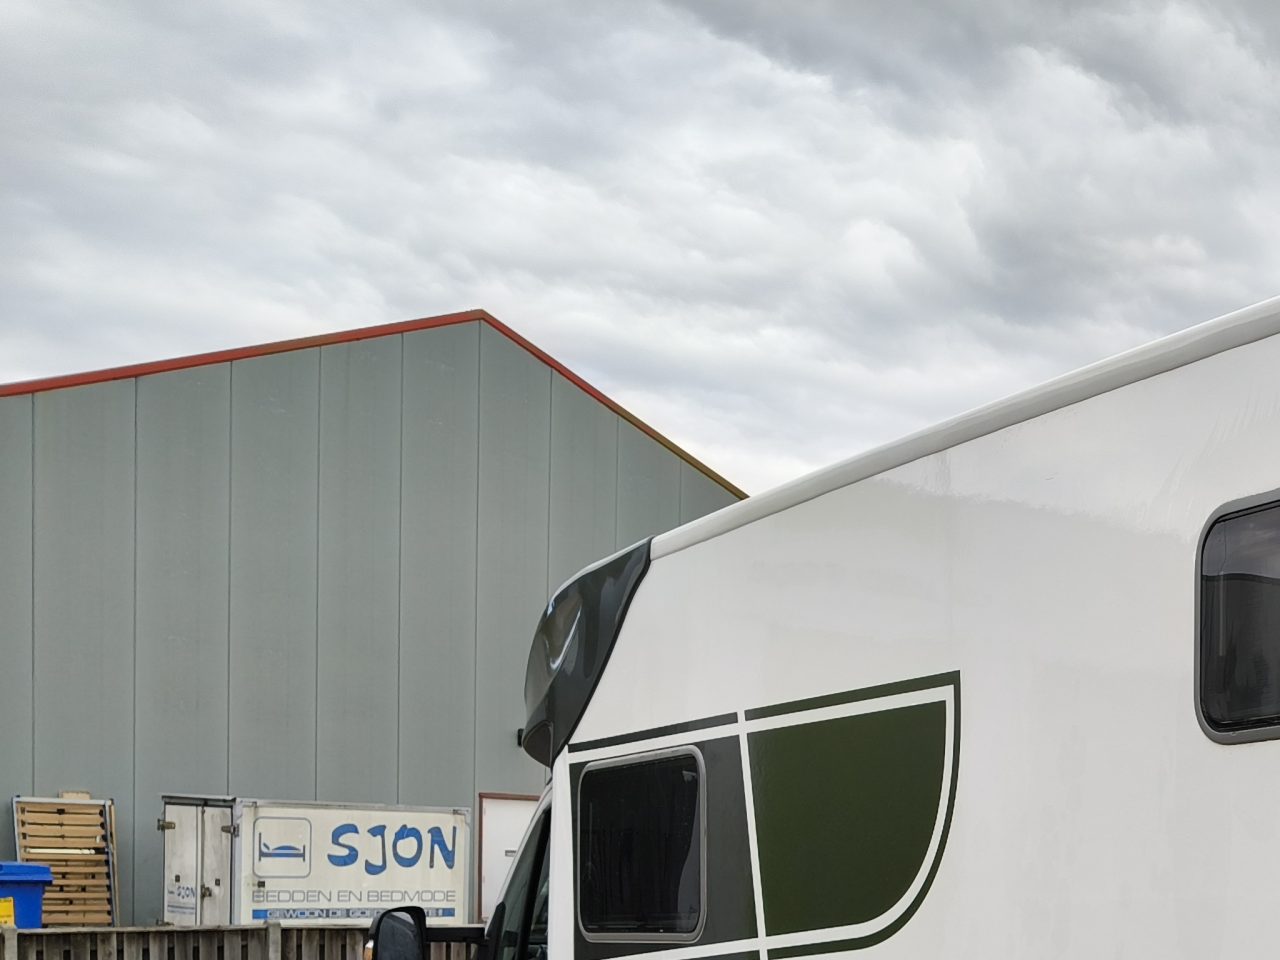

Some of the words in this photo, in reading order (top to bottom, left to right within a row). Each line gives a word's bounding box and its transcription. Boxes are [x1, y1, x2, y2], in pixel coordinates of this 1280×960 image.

[327, 823, 457, 876] SJON
[251, 889, 332, 903] BEDDEN
[337, 889, 363, 903] EN
[366, 889, 457, 903] BEDMODE
